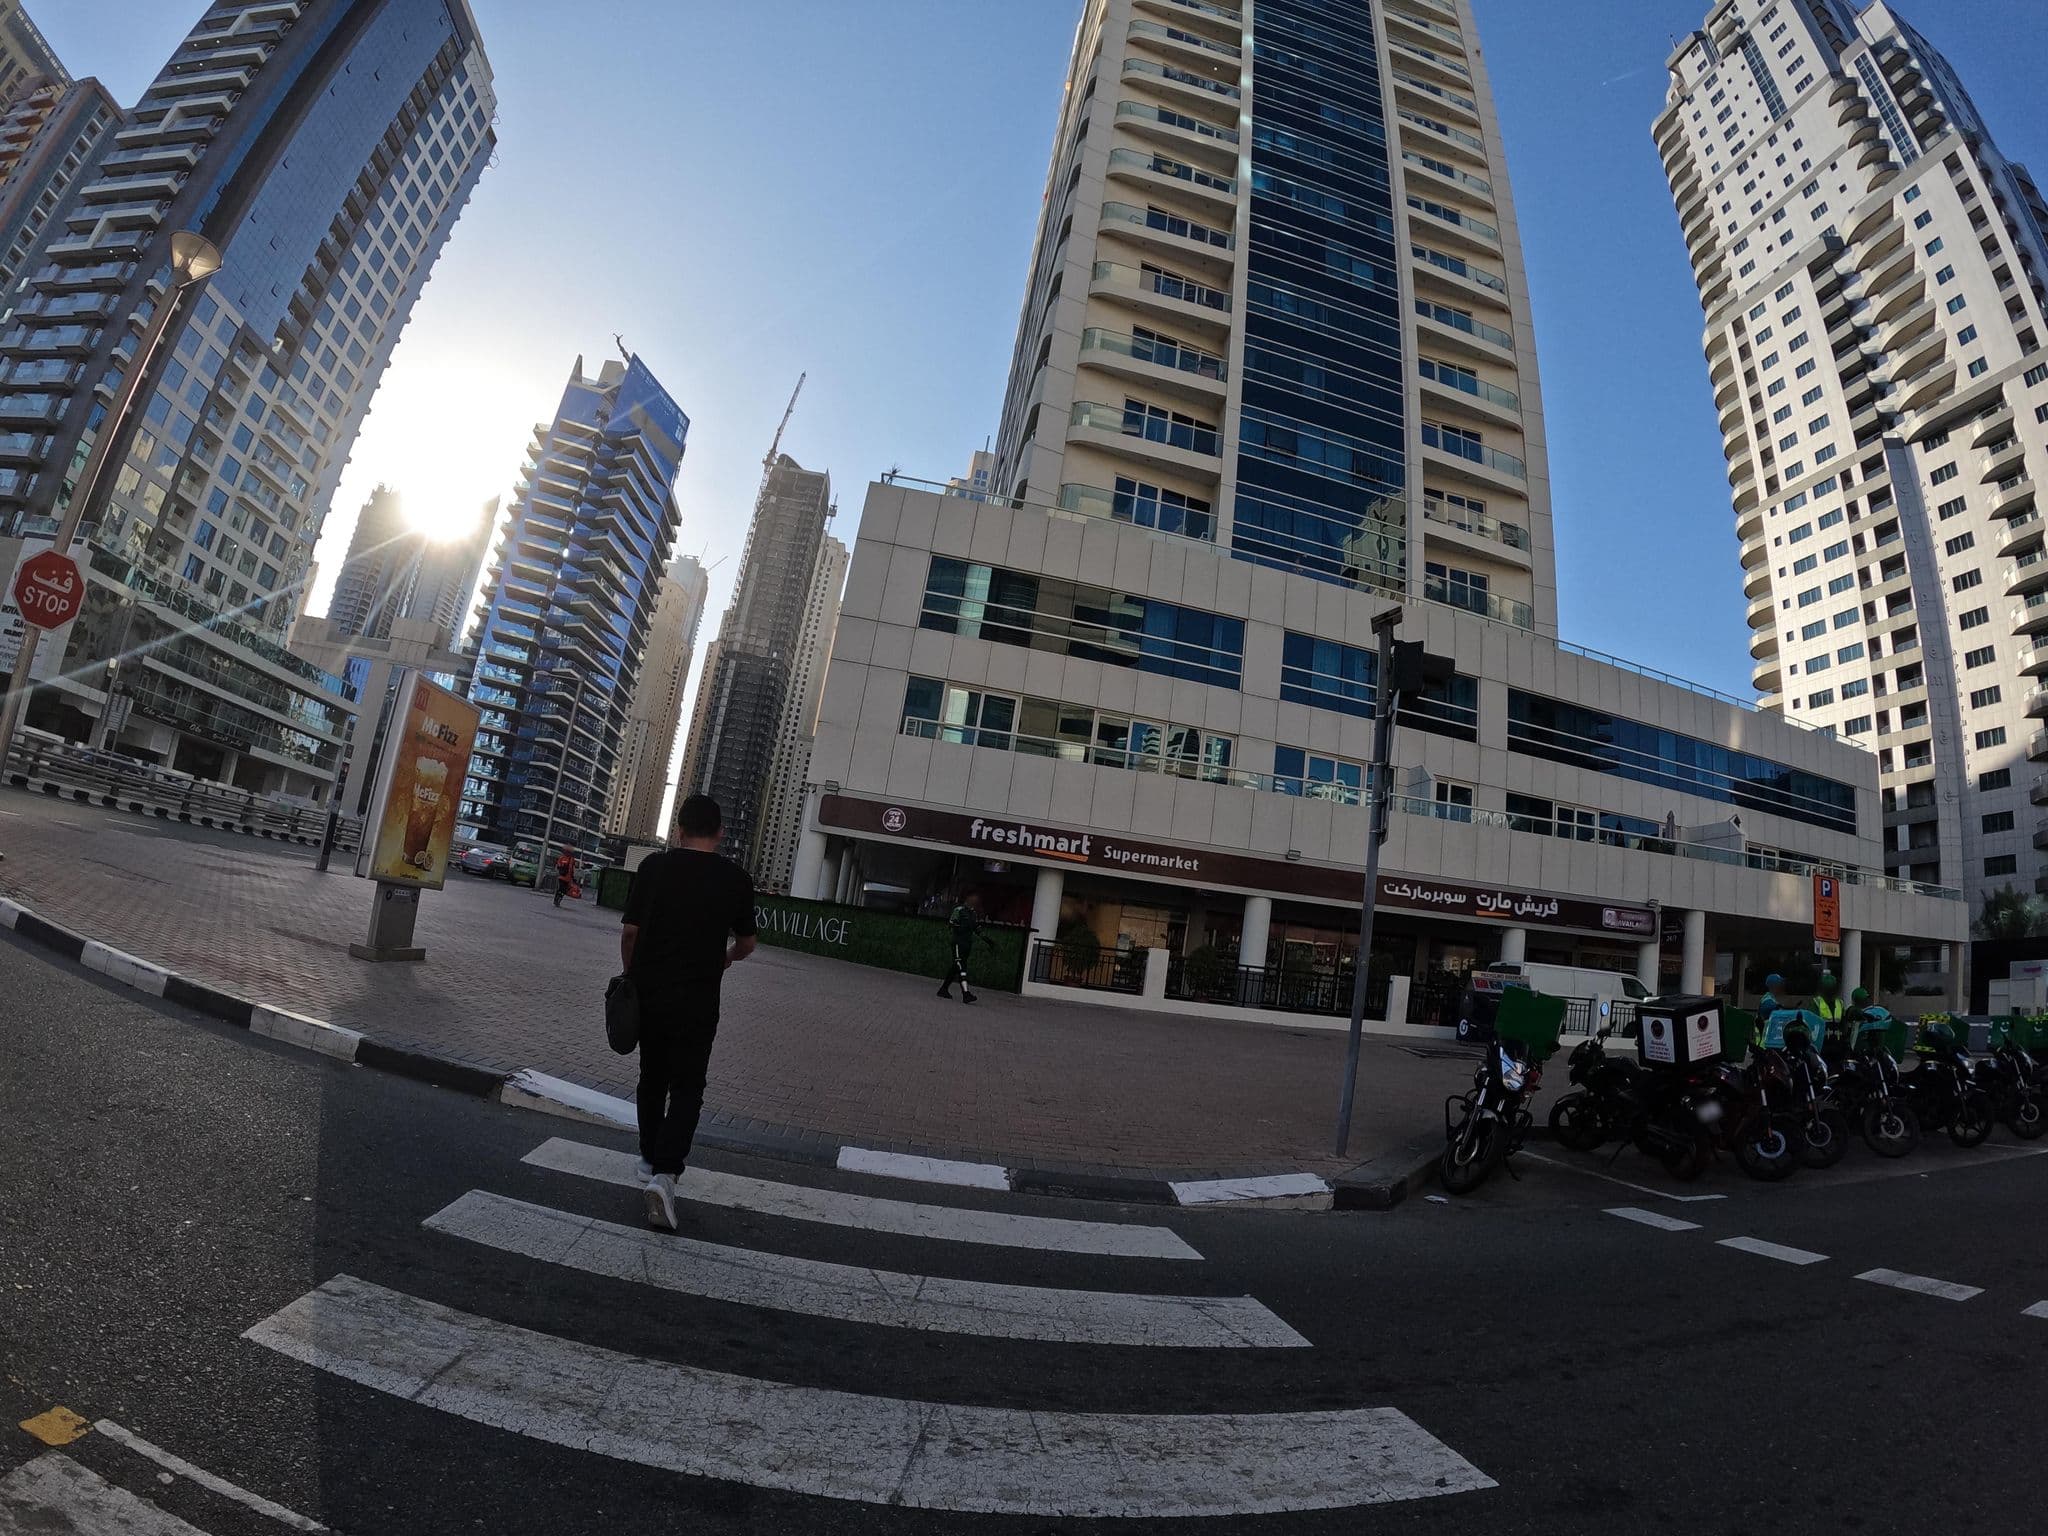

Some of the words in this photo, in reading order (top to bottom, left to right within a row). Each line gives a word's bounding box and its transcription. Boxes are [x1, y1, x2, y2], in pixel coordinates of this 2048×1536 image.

[32, 567, 74, 594] قف
[23, 586, 69, 615] STOP
[889, 815, 900, 823] 24
[970, 818, 1091, 855] freshmart
[1104, 845, 1200, 871] Supermarket
[1383, 883, 1467, 904] سوبرماركت
[1822, 879, 1831, 896] P
[1476, 892, 1512, 911] مارت
[1514, 895, 1559, 918] فريش
[782, 909, 853, 945] VILLAGE
